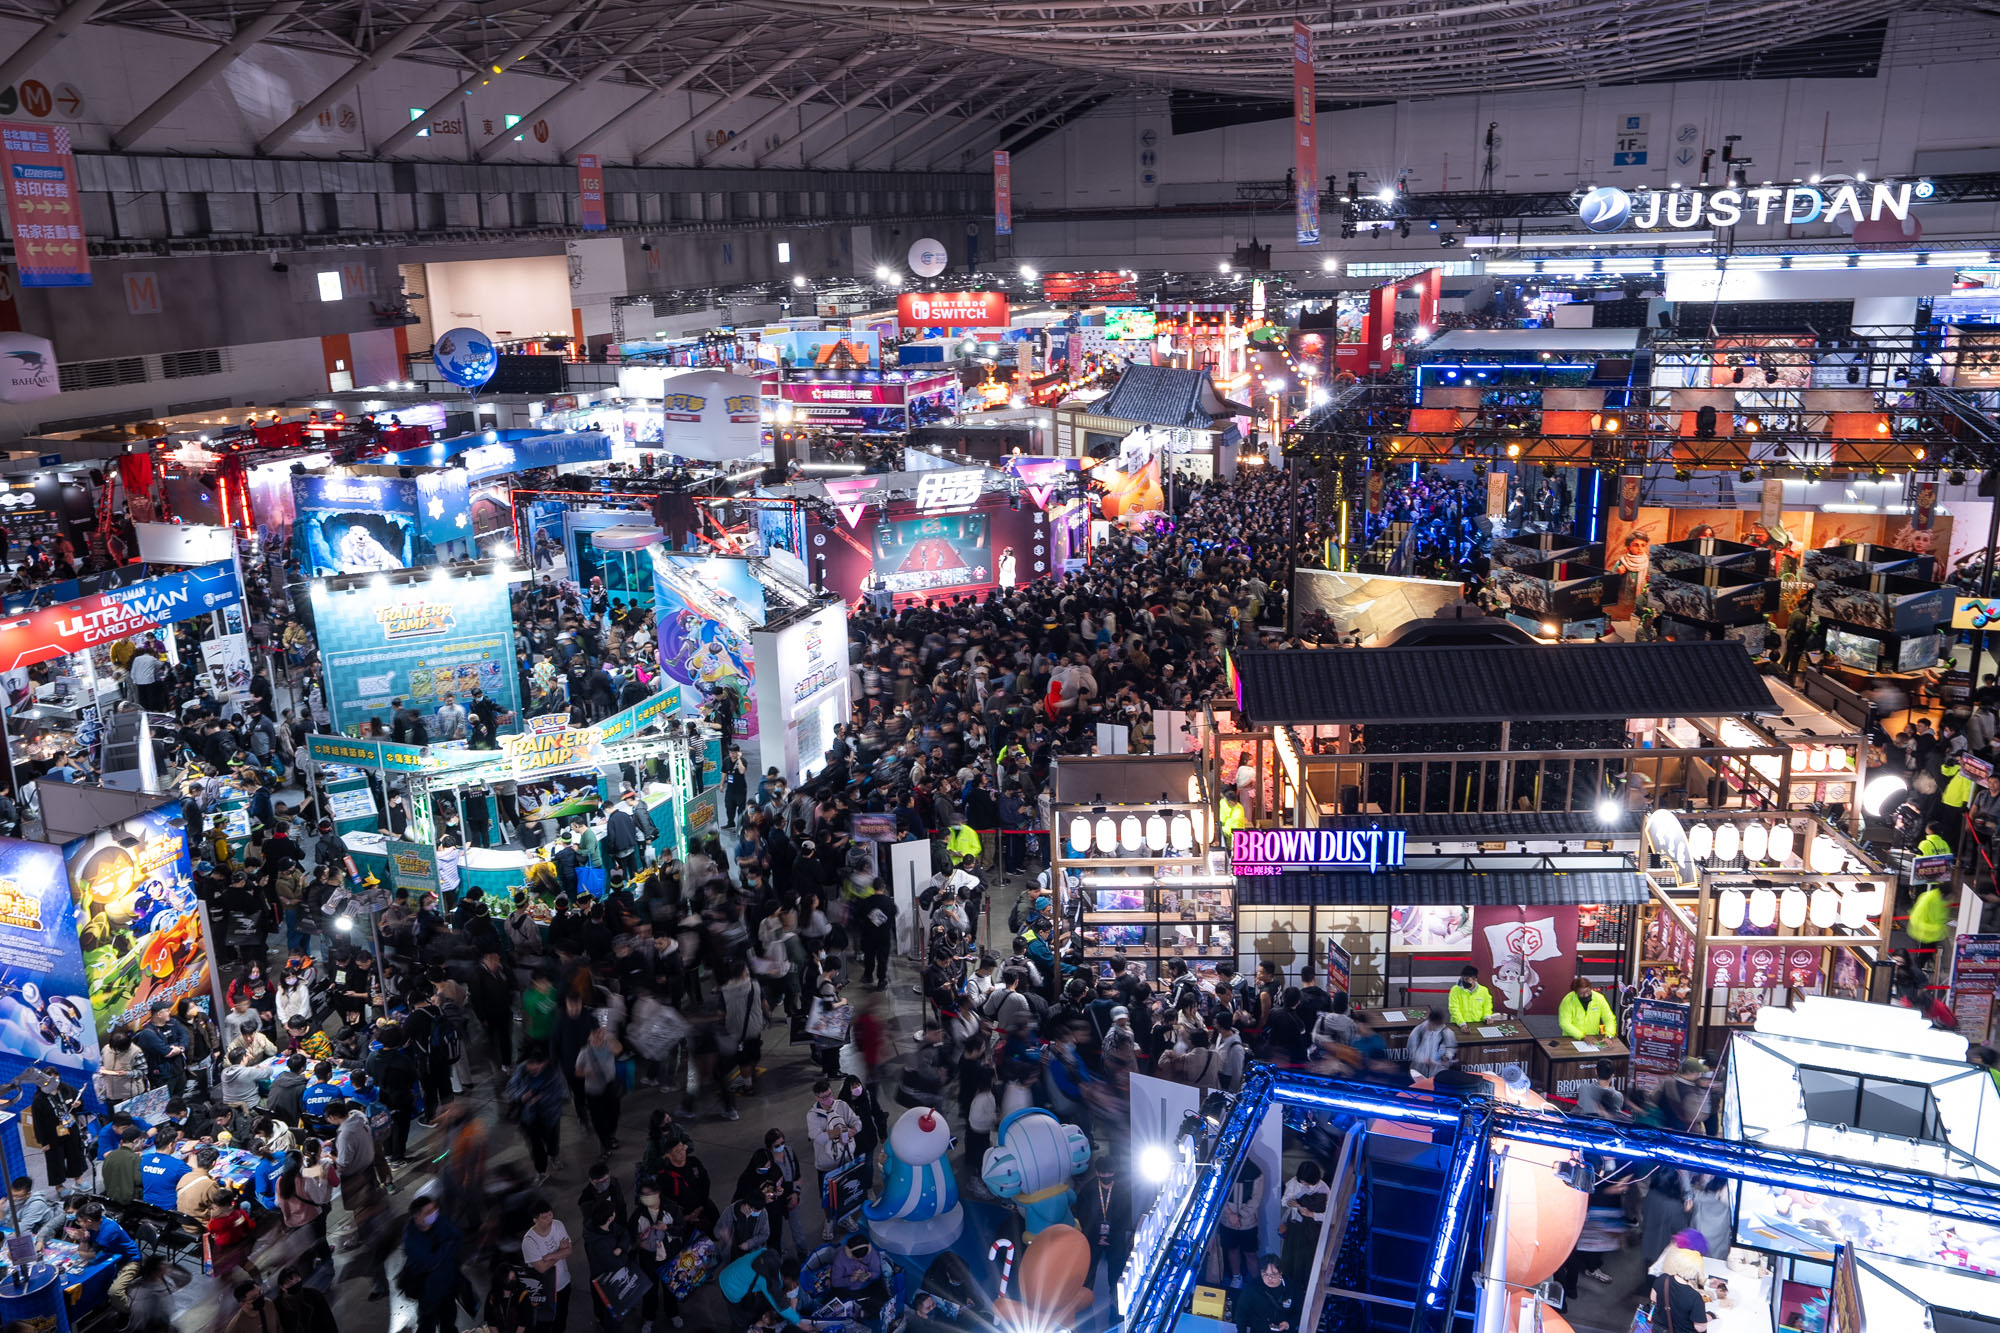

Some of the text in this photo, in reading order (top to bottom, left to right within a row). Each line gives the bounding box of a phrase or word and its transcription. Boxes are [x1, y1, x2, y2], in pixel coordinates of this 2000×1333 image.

[482, 119, 494, 136] 東
[1617, 138, 1638, 151] 1F
[14, 180, 69, 199] 封印任務
[1635, 184, 1912, 229] JUSTDAN
[17, 223, 82, 240] 玩家活動區
[128, 276, 157, 312] M
[931, 308, 987, 320] SWITCH
[1780, 581, 1816, 591] UNTER
[55, 586, 189, 637] ULTRAMAN
[84, 608, 172, 643] CARD GAME
[387, 617, 431, 633] CAMP
[499, 730, 602, 756] TRAINERS
[518, 748, 575, 772] CAMP
[1232, 826, 1406, 872] BROWN DUST II
[307, 1096, 332, 1105] CREW
[143, 1165, 166, 1176] CREW
